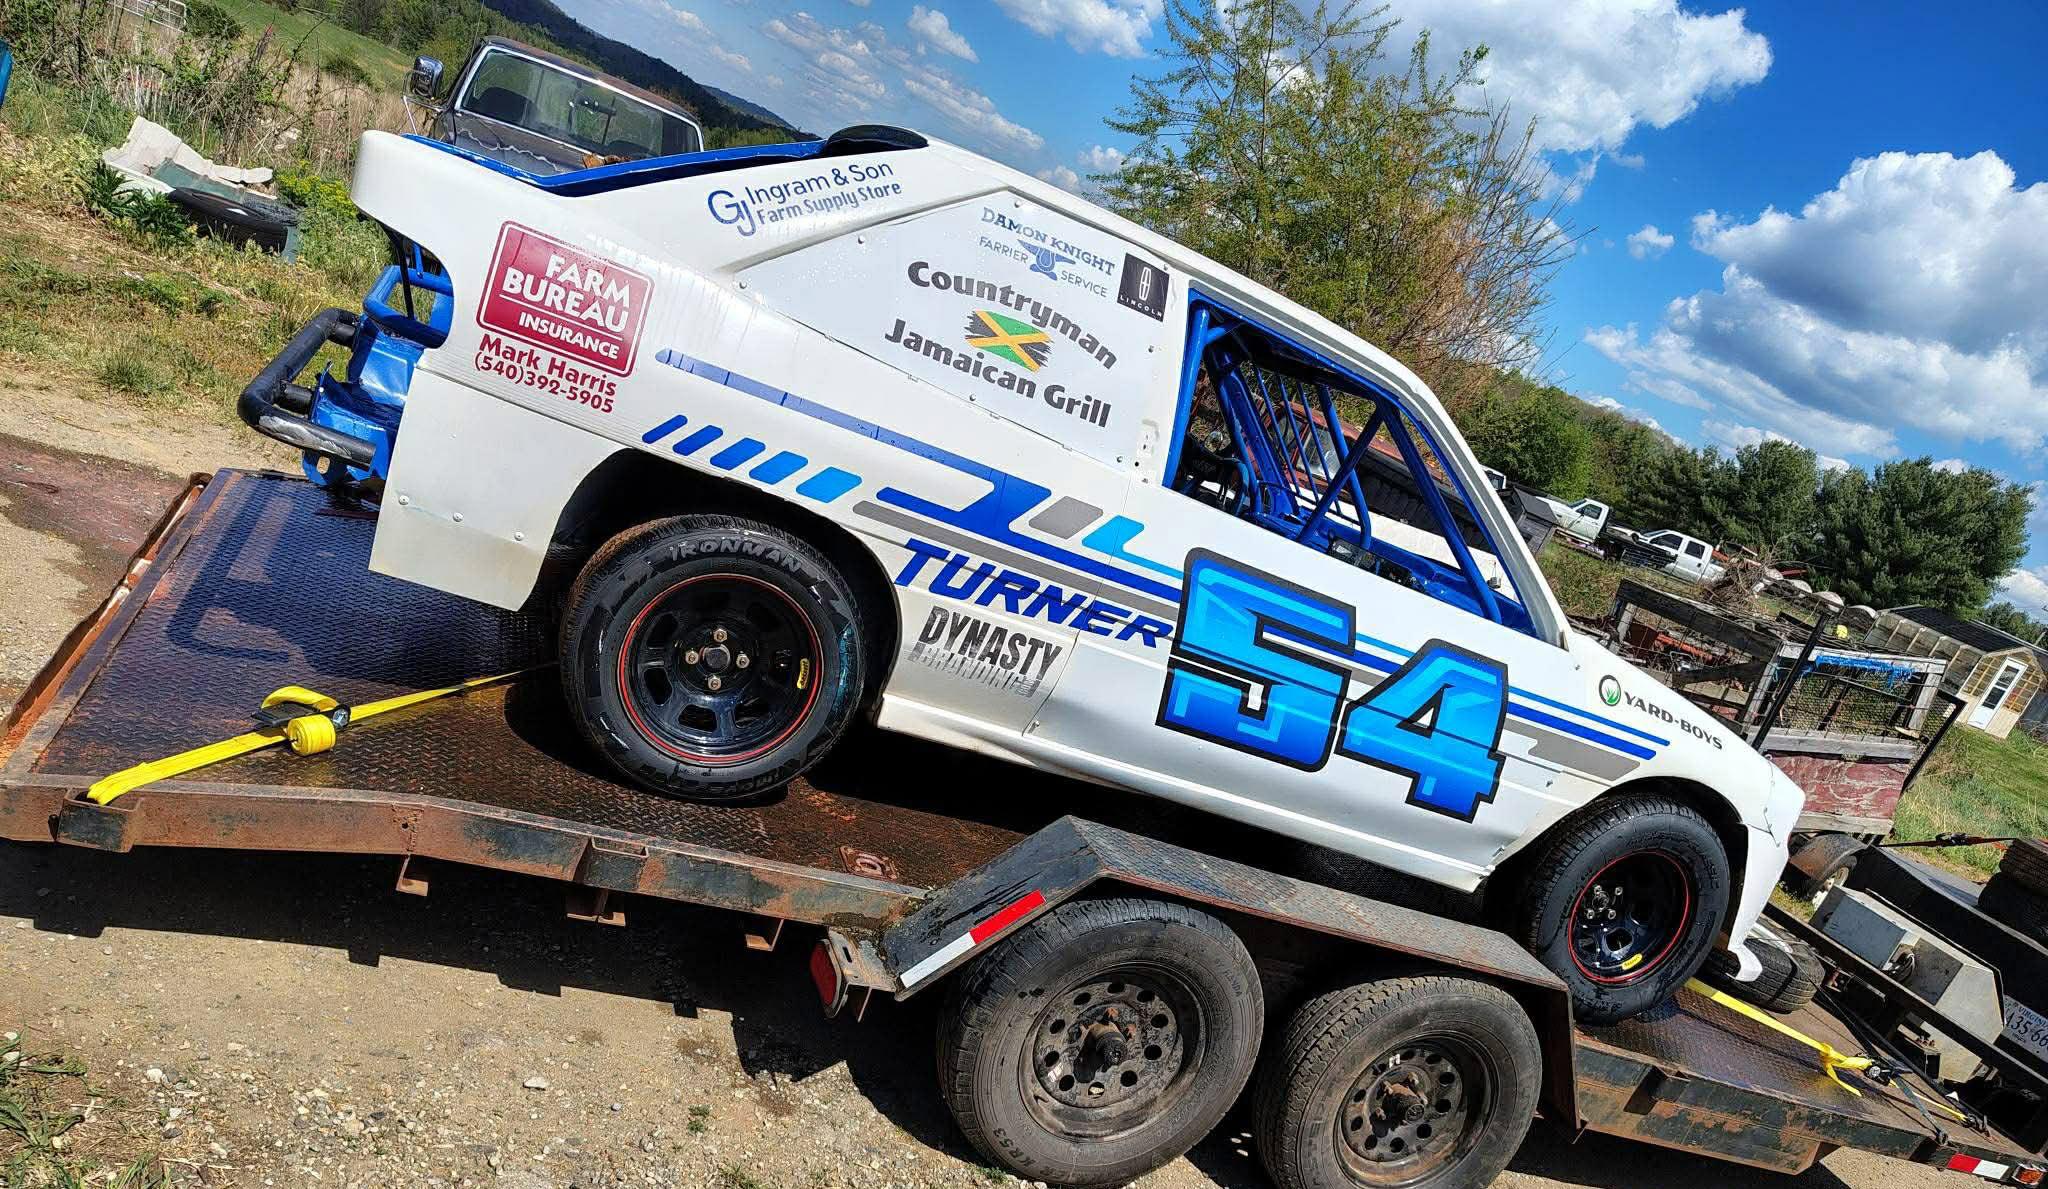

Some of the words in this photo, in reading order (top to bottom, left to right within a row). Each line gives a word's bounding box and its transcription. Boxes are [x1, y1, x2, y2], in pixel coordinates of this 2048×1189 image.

[745, 175, 831, 206] Ingram
[831, 167, 850, 186] &
[849, 162, 894, 183] Son
[756, 201, 803, 225] Farm
[804, 190, 858, 214] Supply
[857, 181, 902, 202] Store
[979, 236, 1030, 264] FARRIER
[1060, 270, 1109, 298] SERVICE
[981, 206, 1048, 243] DAMON
[1050, 237, 1116, 276] KNIGHT
[502, 266, 630, 333] BUREAU
[545, 252, 631, 308] FARM
[1119, 295, 1163, 317] LINCOLN
[518, 311, 621, 360] INSURANCE
[907, 260, 1118, 370] Countryman
[474, 350, 614, 414] (540)392-5905
[478, 333, 541, 370] Mark
[546, 356, 617, 396] Harris
[884, 318, 1037, 399] Jamaican
[1043, 384, 1112, 428] Grill
[669, 536, 803, 573] IRONMAN
[894, 538, 1174, 649] TURNER
[918, 605, 1062, 681] DYNASTY
[1155, 547, 1509, 824] 54
[1623, 691, 1723, 750] YARD-BOYS
